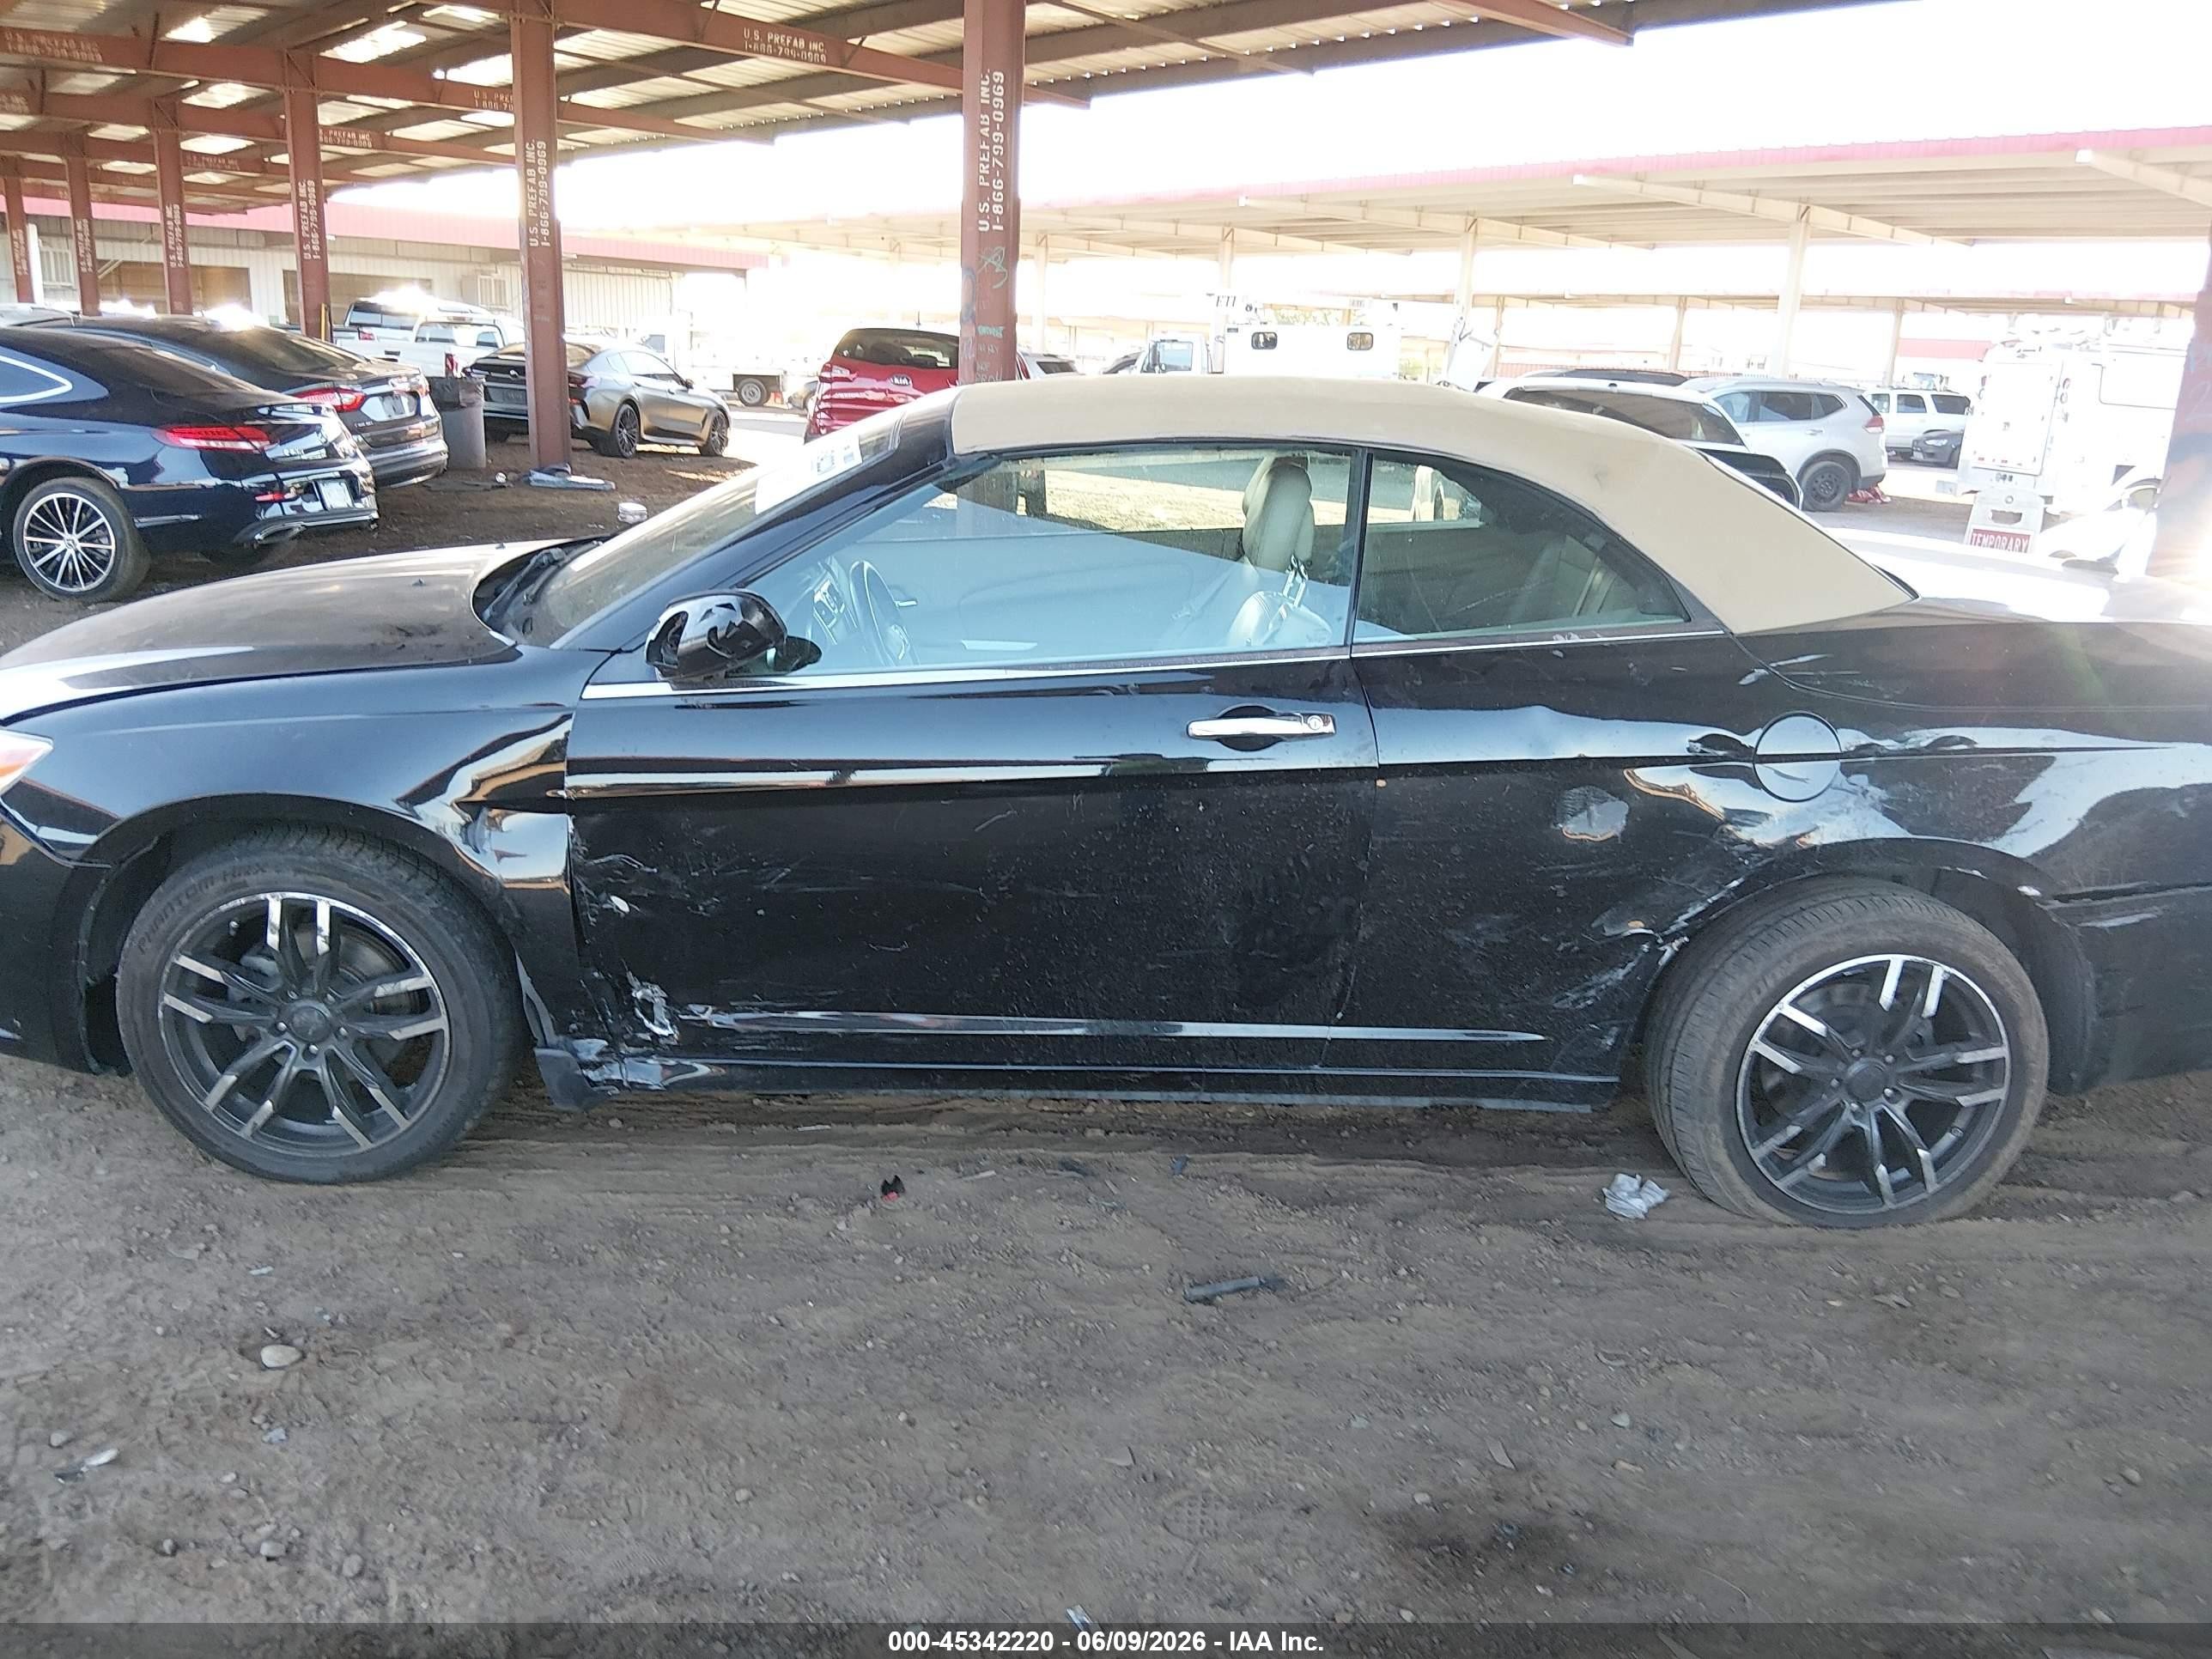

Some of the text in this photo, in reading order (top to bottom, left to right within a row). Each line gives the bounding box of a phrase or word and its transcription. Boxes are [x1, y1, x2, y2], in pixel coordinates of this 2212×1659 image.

[744, 27, 827, 53] U.S. PREFAB INC.
[526, 138, 539, 247] U.S. PREFAB INC.
[537, 141, 551, 247] 1-866-799-0969
[979, 68, 991, 233] U.S. PREFAB INC.
[992, 70, 1005, 231] 1-866-799-0969
[299, 200, 310, 238] PREFAB
[1971, 532, 2029, 553] TEMPORARY
